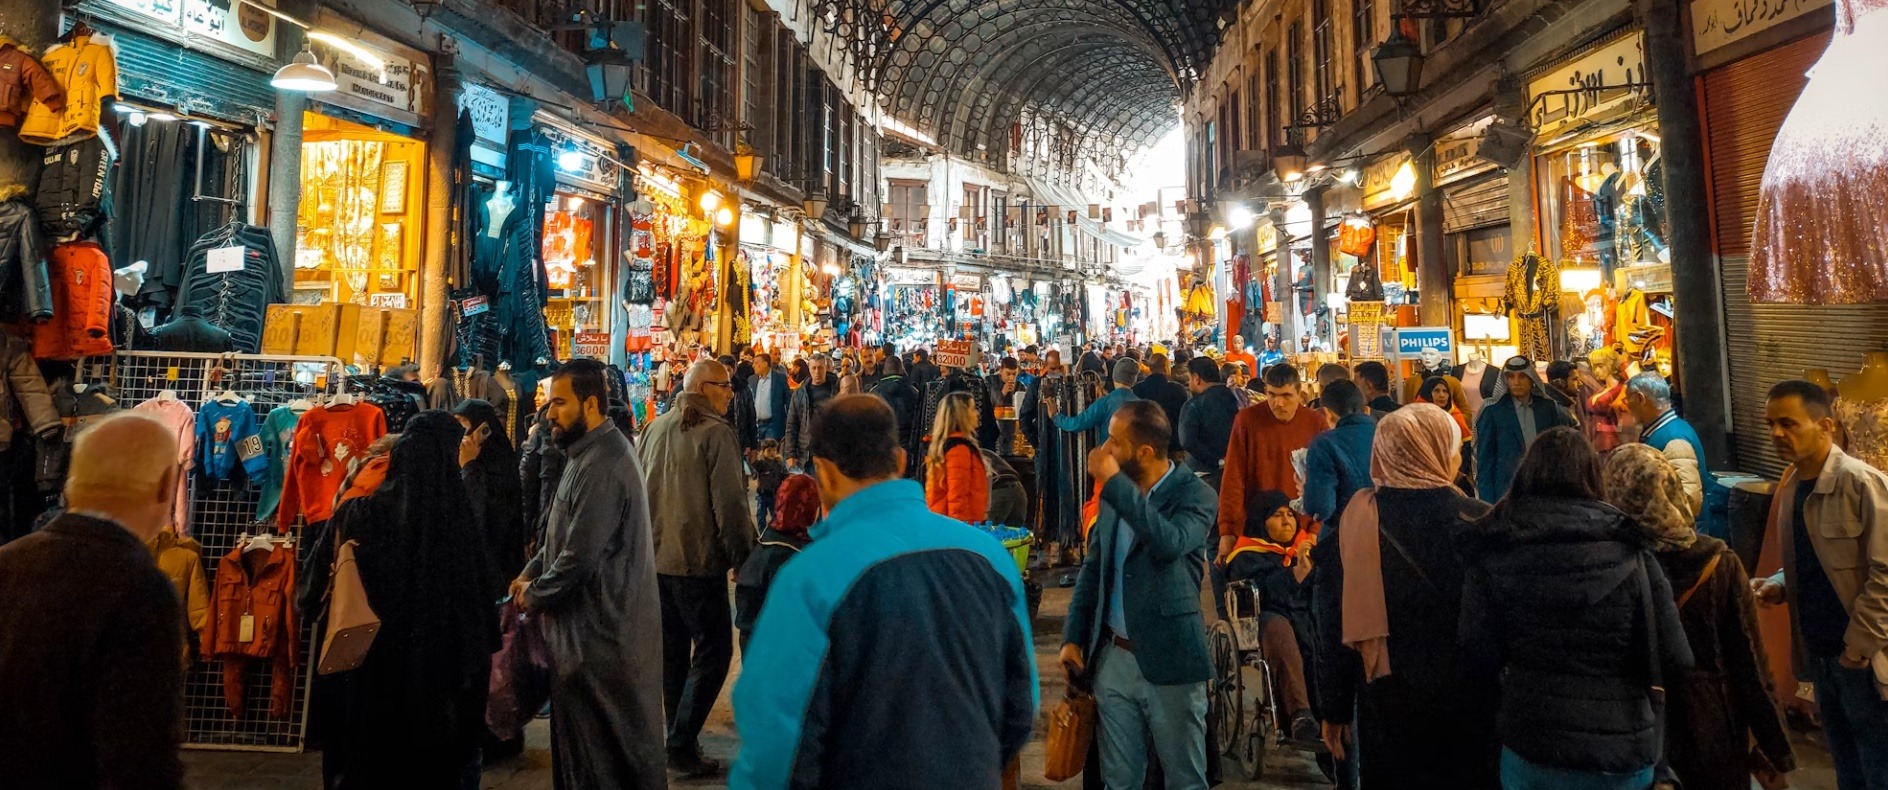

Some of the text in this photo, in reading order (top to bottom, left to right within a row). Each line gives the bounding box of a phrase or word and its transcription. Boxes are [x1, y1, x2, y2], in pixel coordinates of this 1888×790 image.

[96, 149, 109, 178] GREEN
[577, 334, 608, 344] يا بلاش
[1401, 337, 1448, 348] PHILIPS
[575, 345, 605, 355] 36000
[938, 354, 966, 366] 32000
[244, 436, 261, 454] 19
